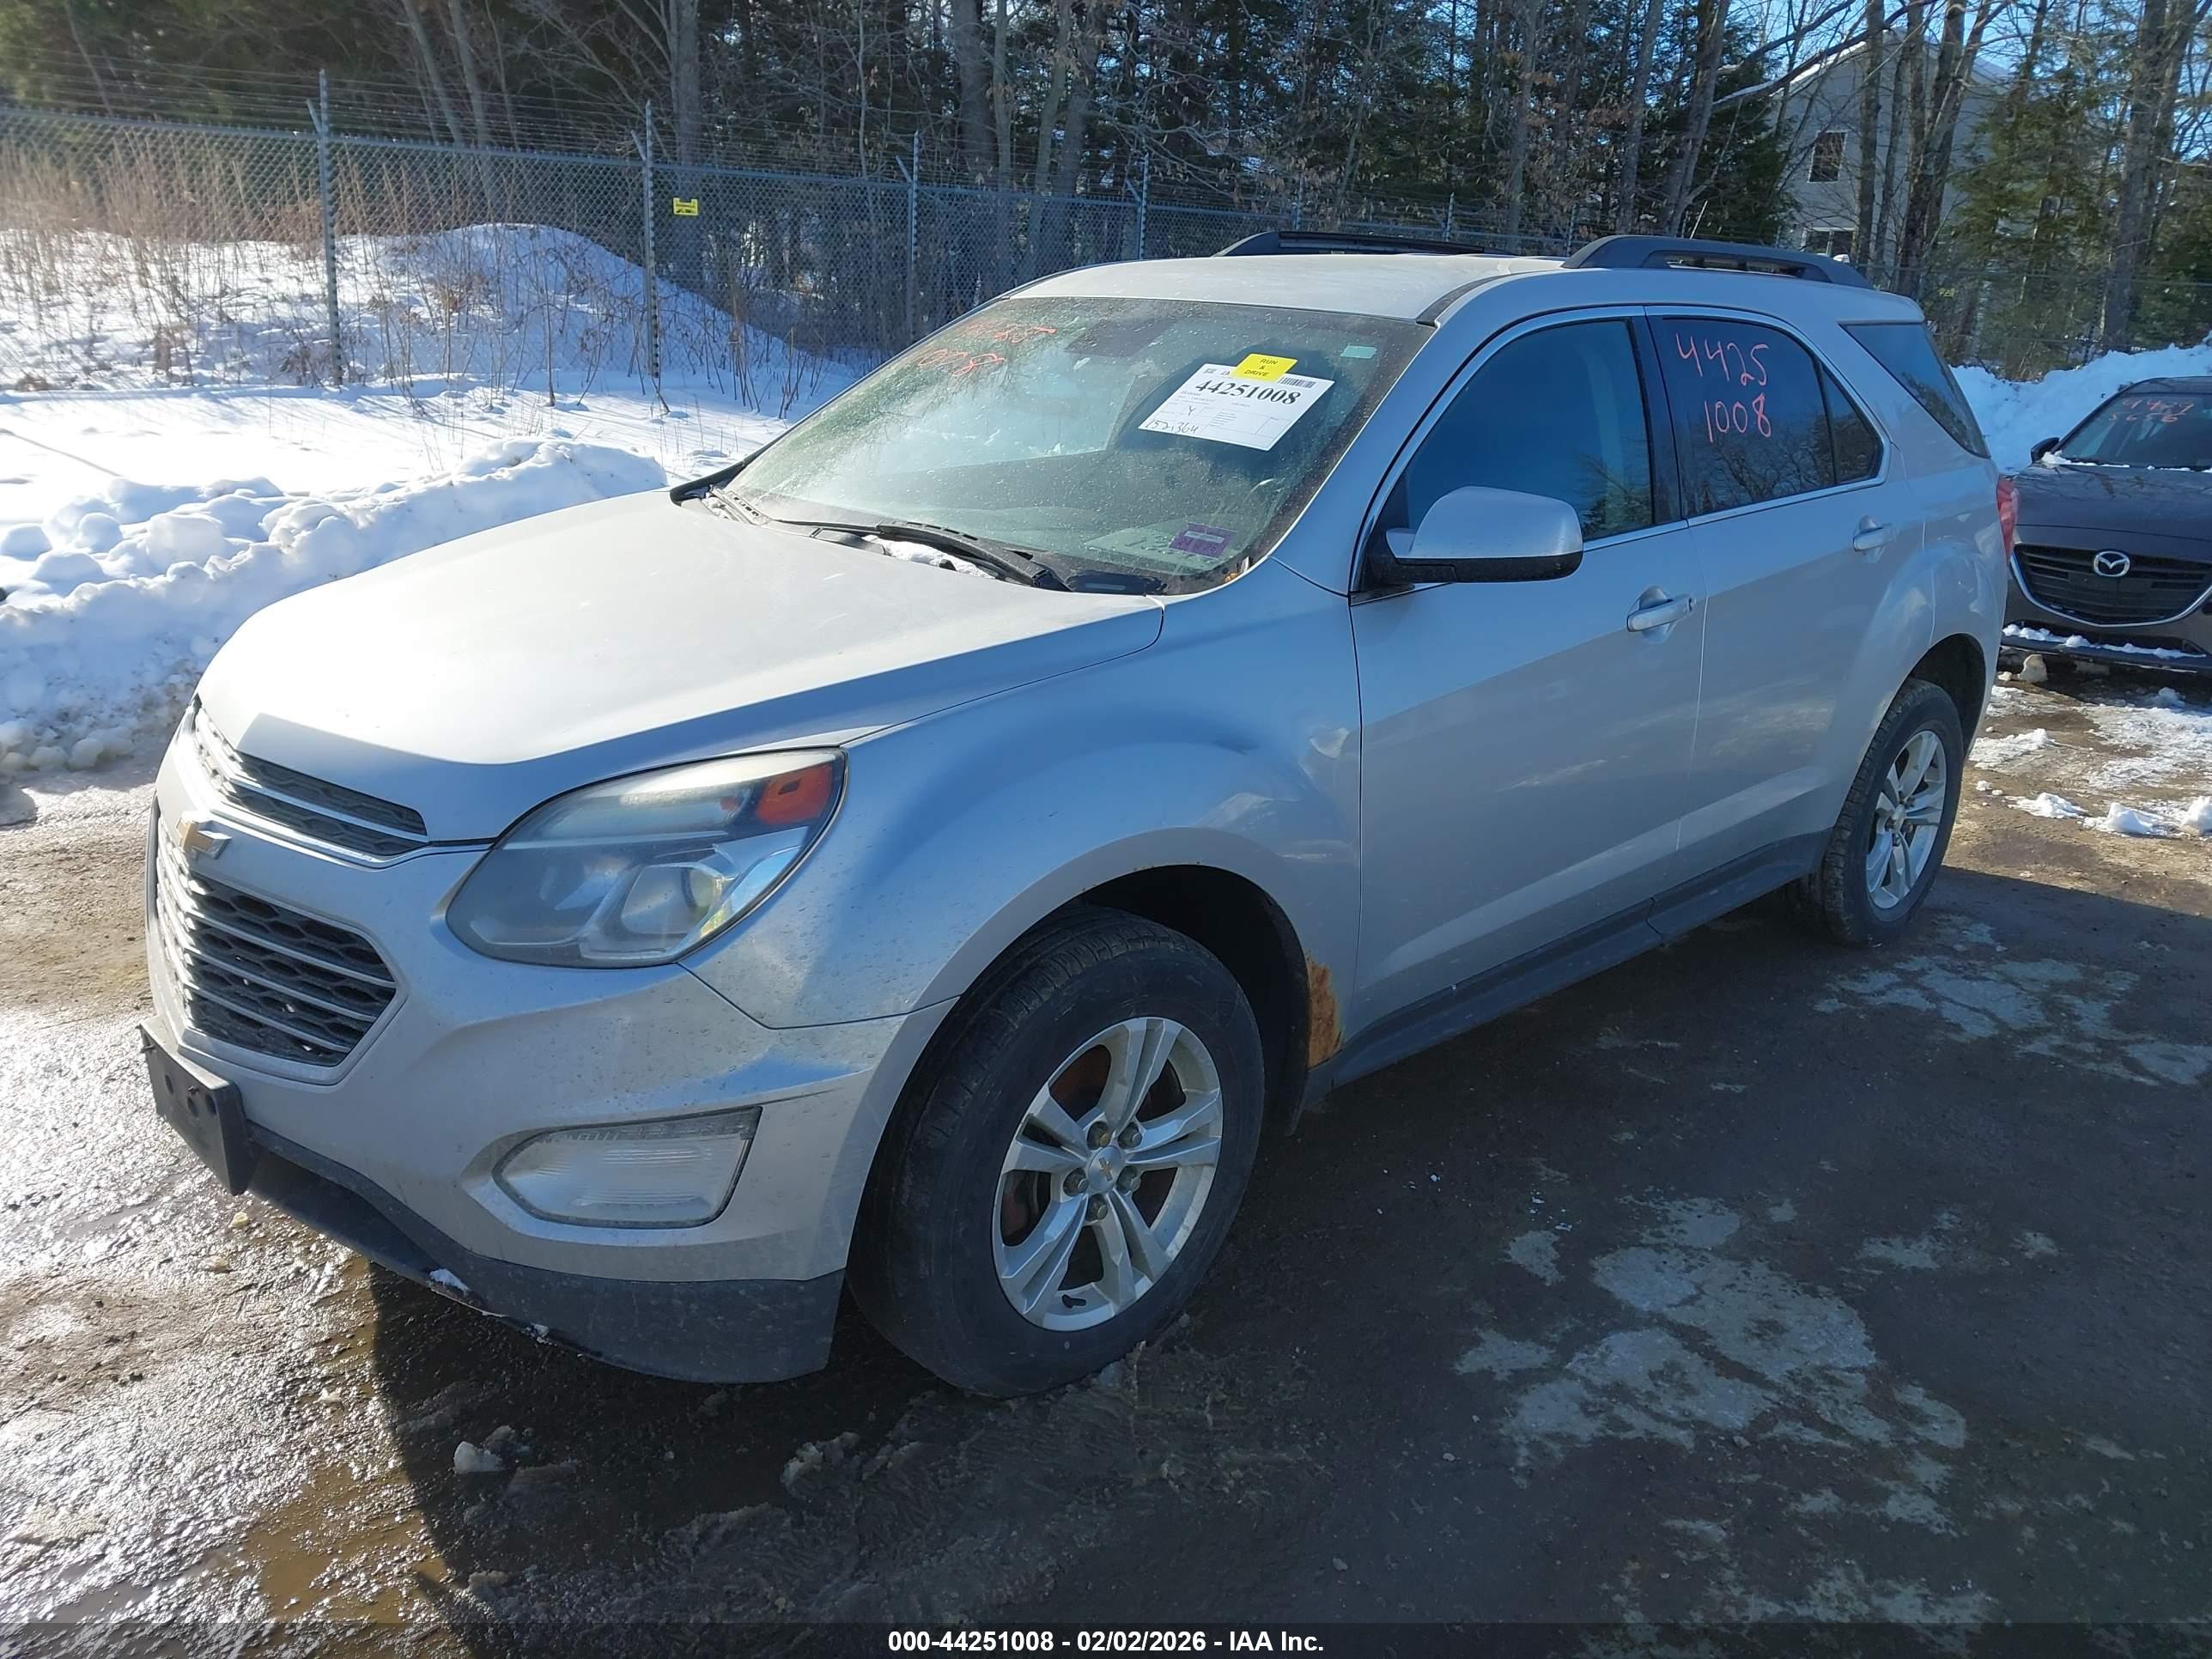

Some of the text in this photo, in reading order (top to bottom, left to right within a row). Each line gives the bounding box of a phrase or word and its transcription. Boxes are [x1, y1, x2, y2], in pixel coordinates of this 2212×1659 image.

[1675, 332, 1769, 386] 4425
[1194, 379, 1302, 405] 44251008
[1704, 392, 1771, 444] 1008
